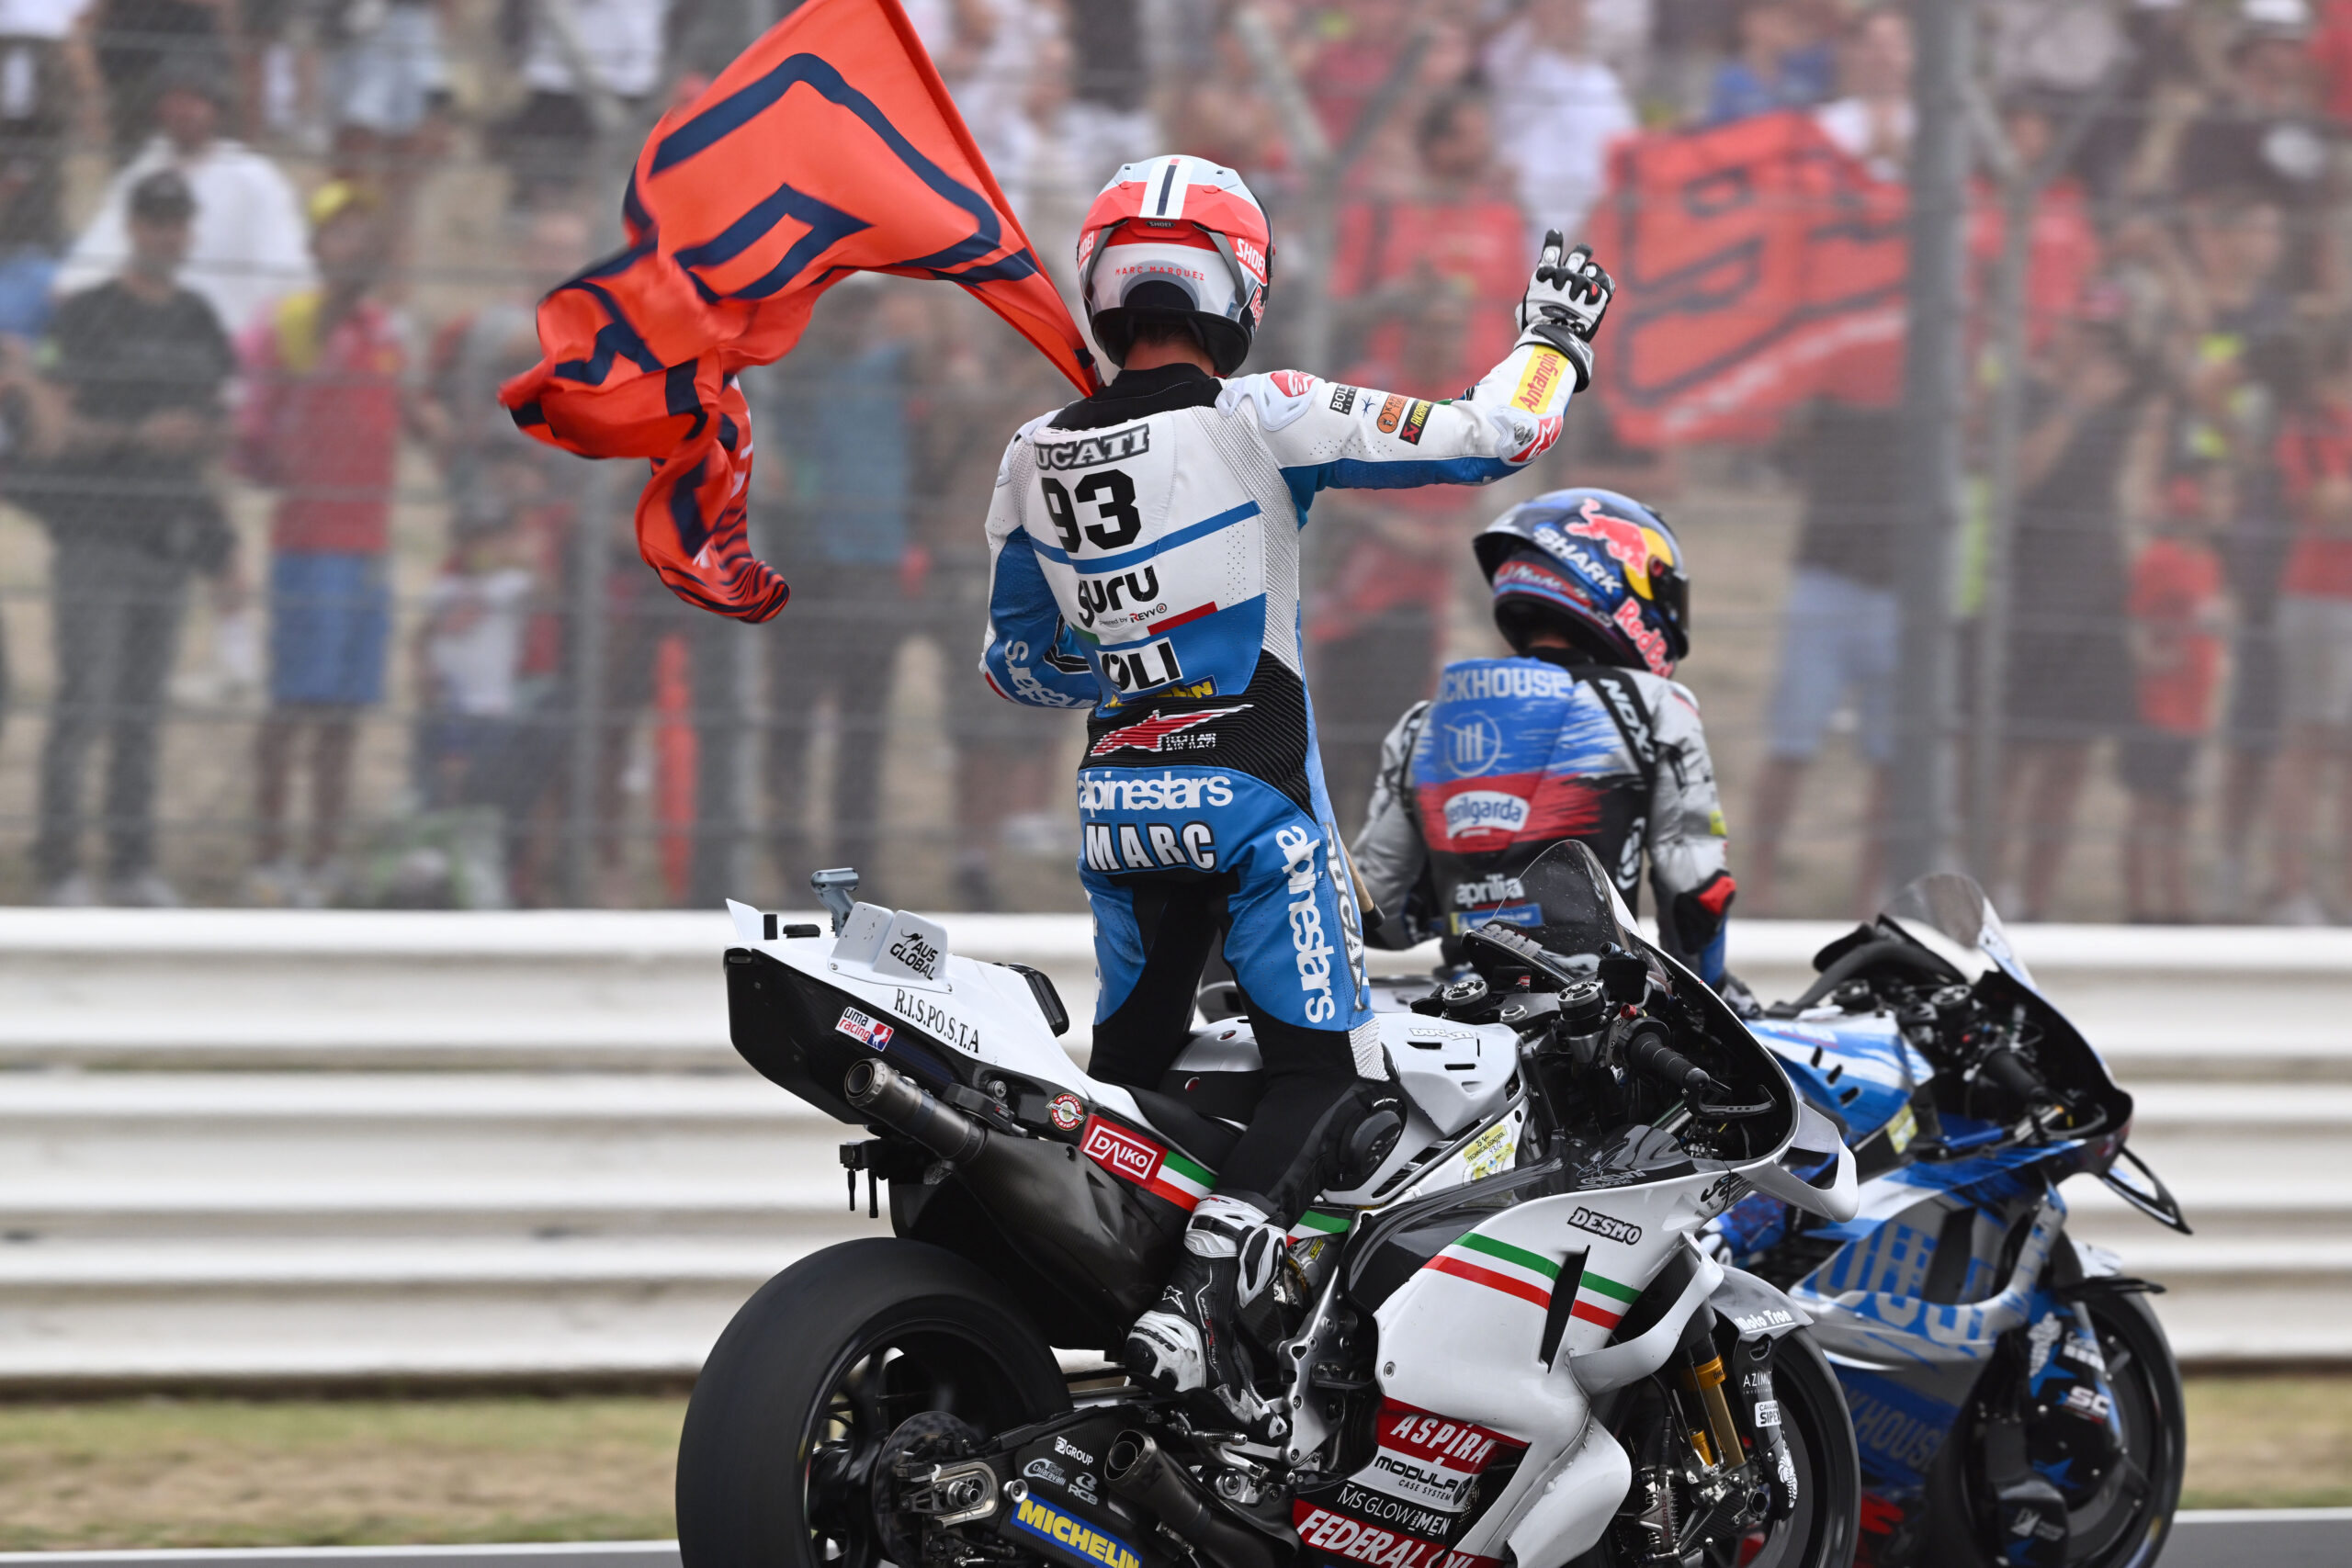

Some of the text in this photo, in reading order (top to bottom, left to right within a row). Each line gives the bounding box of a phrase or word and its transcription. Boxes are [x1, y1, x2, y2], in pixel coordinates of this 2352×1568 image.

[1114, 265, 1205, 281] MARC MARQUEZ
[1236, 238, 1266, 277] SHOEI
[1519, 353, 1560, 413] Antangin
[1040, 468, 1142, 553] 93
[1532, 527, 1623, 595] SHARK
[1442, 667, 1574, 703] CKHOUSE
[1079, 772, 1234, 818] alpinestars
[1086, 822, 1217, 871] MARC
[1455, 873, 1525, 908] aprilia
[1275, 826, 1336, 1023] alpinestars
[889, 942, 936, 980] GLOBAL
[914, 941, 939, 963] AUS
[838, 1018, 871, 1042] racing
[845, 1009, 868, 1026] uma
[1570, 1208, 1641, 1245] DESMO
[1066, 1444, 1093, 1466] GROUP
[1032, 1463, 1067, 1486] Chiaravalli
[1374, 1455, 1459, 1493] MODULA
[1398, 1479, 1452, 1501] CASE SYSTEM
[1068, 1483, 1099, 1506] RCB
[1364, 1496, 1416, 1524] GLOW
[1416, 1512, 1452, 1536] MEN
[1297, 1508, 1427, 1568] FEDERAL
